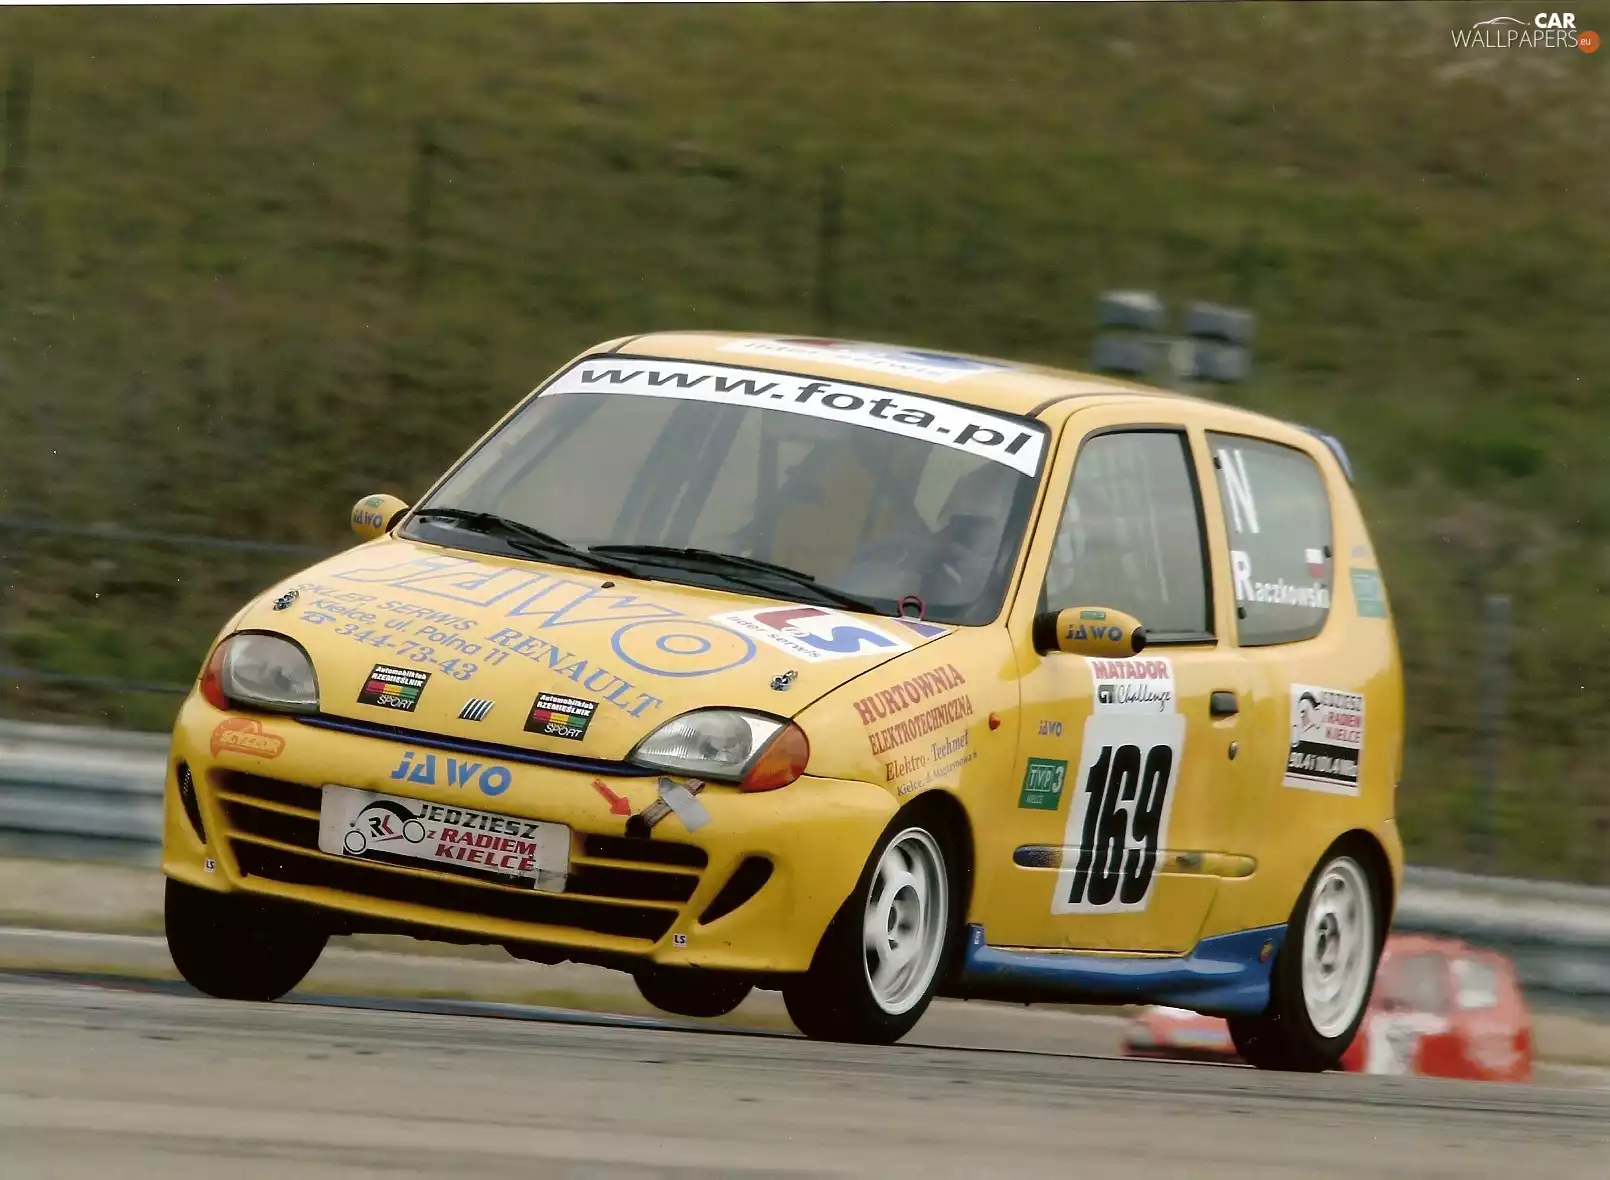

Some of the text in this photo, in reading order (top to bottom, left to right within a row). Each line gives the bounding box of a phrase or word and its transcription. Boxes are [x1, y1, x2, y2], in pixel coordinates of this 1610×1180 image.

[581, 368, 1033, 458] www.fota.pl
[1217, 449, 1260, 534] N
[376, 600, 479, 631] SERWIS
[334, 623, 479, 681] 344-73-43
[413, 625, 483, 656] Polna
[483, 648, 510, 667] 11
[725, 614, 822, 660] lider serwis
[371, 672, 424, 687] RZEMIEŚLNIK
[375, 665, 428, 680] Automobilklub
[485, 627, 665, 719] RENAULT
[1091, 660, 1170, 680] MATADOR
[376, 694, 415, 710] SPORT
[536, 700, 592, 717] RZEMIEŚLNIK
[539, 694, 594, 710] Automobilklub
[853, 663, 967, 726] HURTOWNIA
[1098, 683, 1172, 713] GT Challenge
[543, 722, 583, 737] SPORT
[868, 694, 974, 756] ELEKTROTECHNICZNA
[416, 803, 540, 840] JEDZIESZ
[1068, 744, 1173, 905] 169
[439, 827, 538, 856] RADIEM
[434, 843, 537, 873] KIELCE
[674, 934, 686, 944] LS
